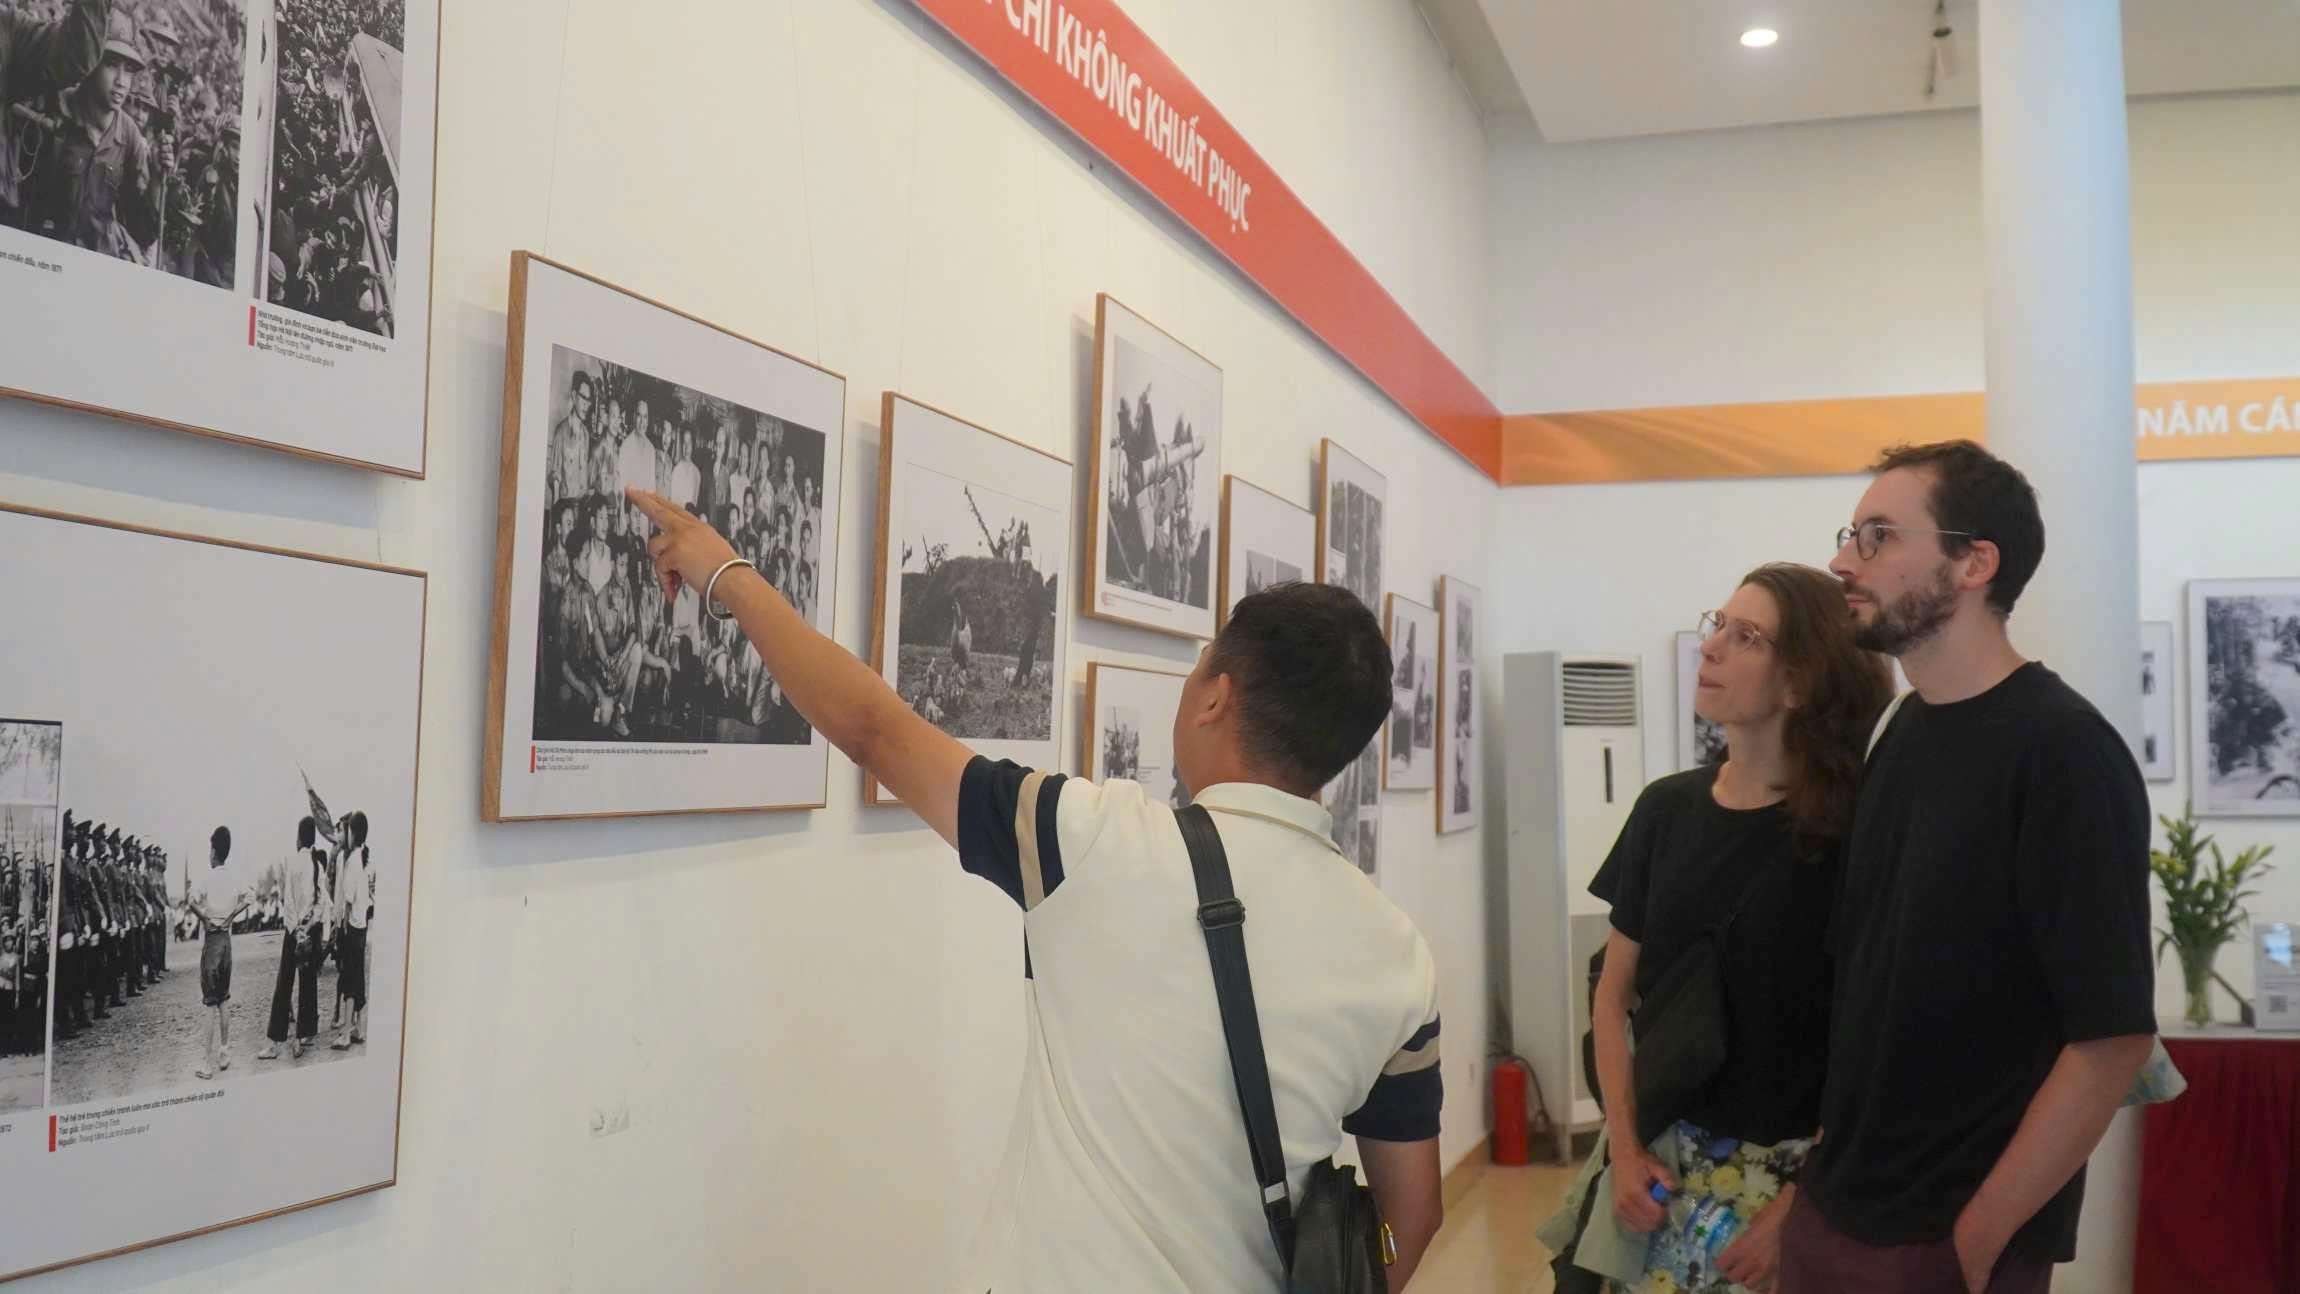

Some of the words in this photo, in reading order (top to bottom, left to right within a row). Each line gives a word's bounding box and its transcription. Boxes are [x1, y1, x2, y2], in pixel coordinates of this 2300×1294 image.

[1055, 4, 1142, 131] KHÔNG
[1144, 85, 1207, 188] KHUẤT
[1207, 148, 1252, 233] PHỤC
[2137, 399, 2230, 437] NĂM
